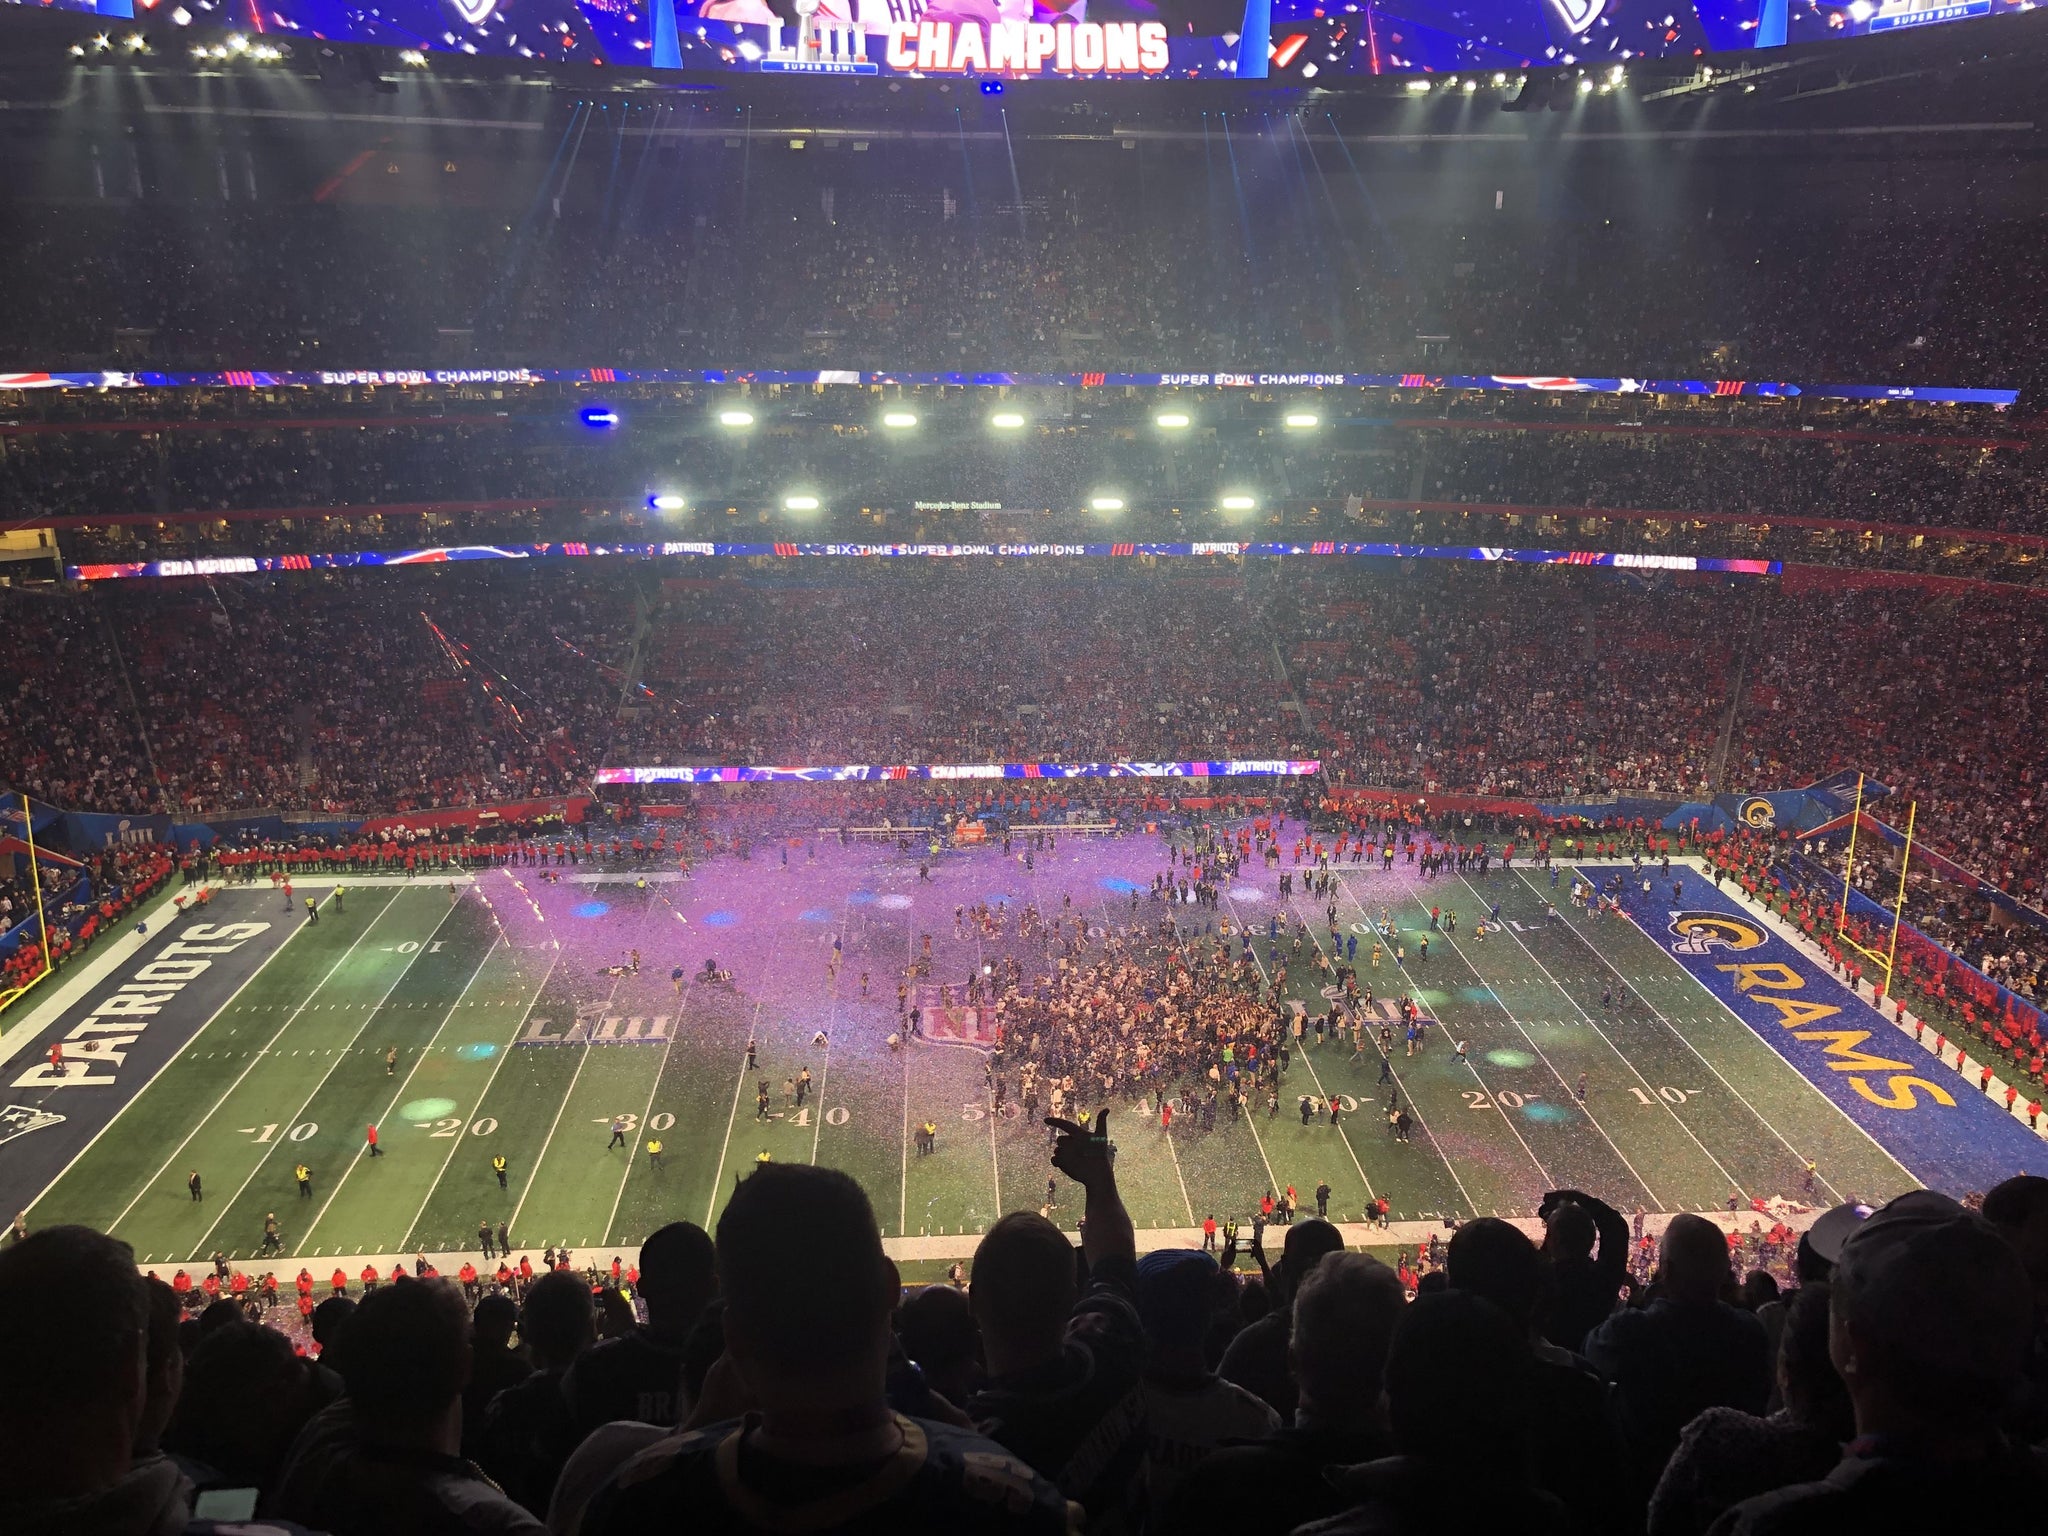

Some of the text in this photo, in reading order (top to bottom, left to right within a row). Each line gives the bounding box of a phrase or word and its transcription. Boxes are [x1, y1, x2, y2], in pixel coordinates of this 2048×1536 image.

[1893, 7, 1969, 26] SUPER BOWL
[887, 22, 1169, 73] CHAMPIONS
[783, 63, 857, 72] SUPER BOWL
[323, 369, 531, 384] SUPER BOWL CHAMPIONS
[1161, 374, 1345, 385] SUPER BOWL CHAMPIONS
[970, 501, 1002, 510] Stadium
[664, 542, 715, 556] PATRIOTS
[826, 544, 1085, 555] SIX-TIME SUPER BOWL CHAMPIONS
[1192, 542, 1239, 555] PATRIOTS
[159, 557, 258, 577] CHAMPIONS
[1613, 554, 1697, 570] CHAMPIONS
[634, 767, 694, 783] PATRIOTS
[931, 765, 1004, 779] CHAMPIONS
[1231, 761, 1288, 775] PATRIOTS
[10, 922, 271, 1088] PATRIOTS
[1715, 963, 1957, 1110] RAMS
[1461, 1090, 1524, 1109] 20
[1628, 1086, 1687, 1105] 10
[615, 1113, 676, 1132] 30
[788, 1107, 850, 1127] 40
[251, 1122, 319, 1143] 10
[429, 1118, 498, 1138] 20
